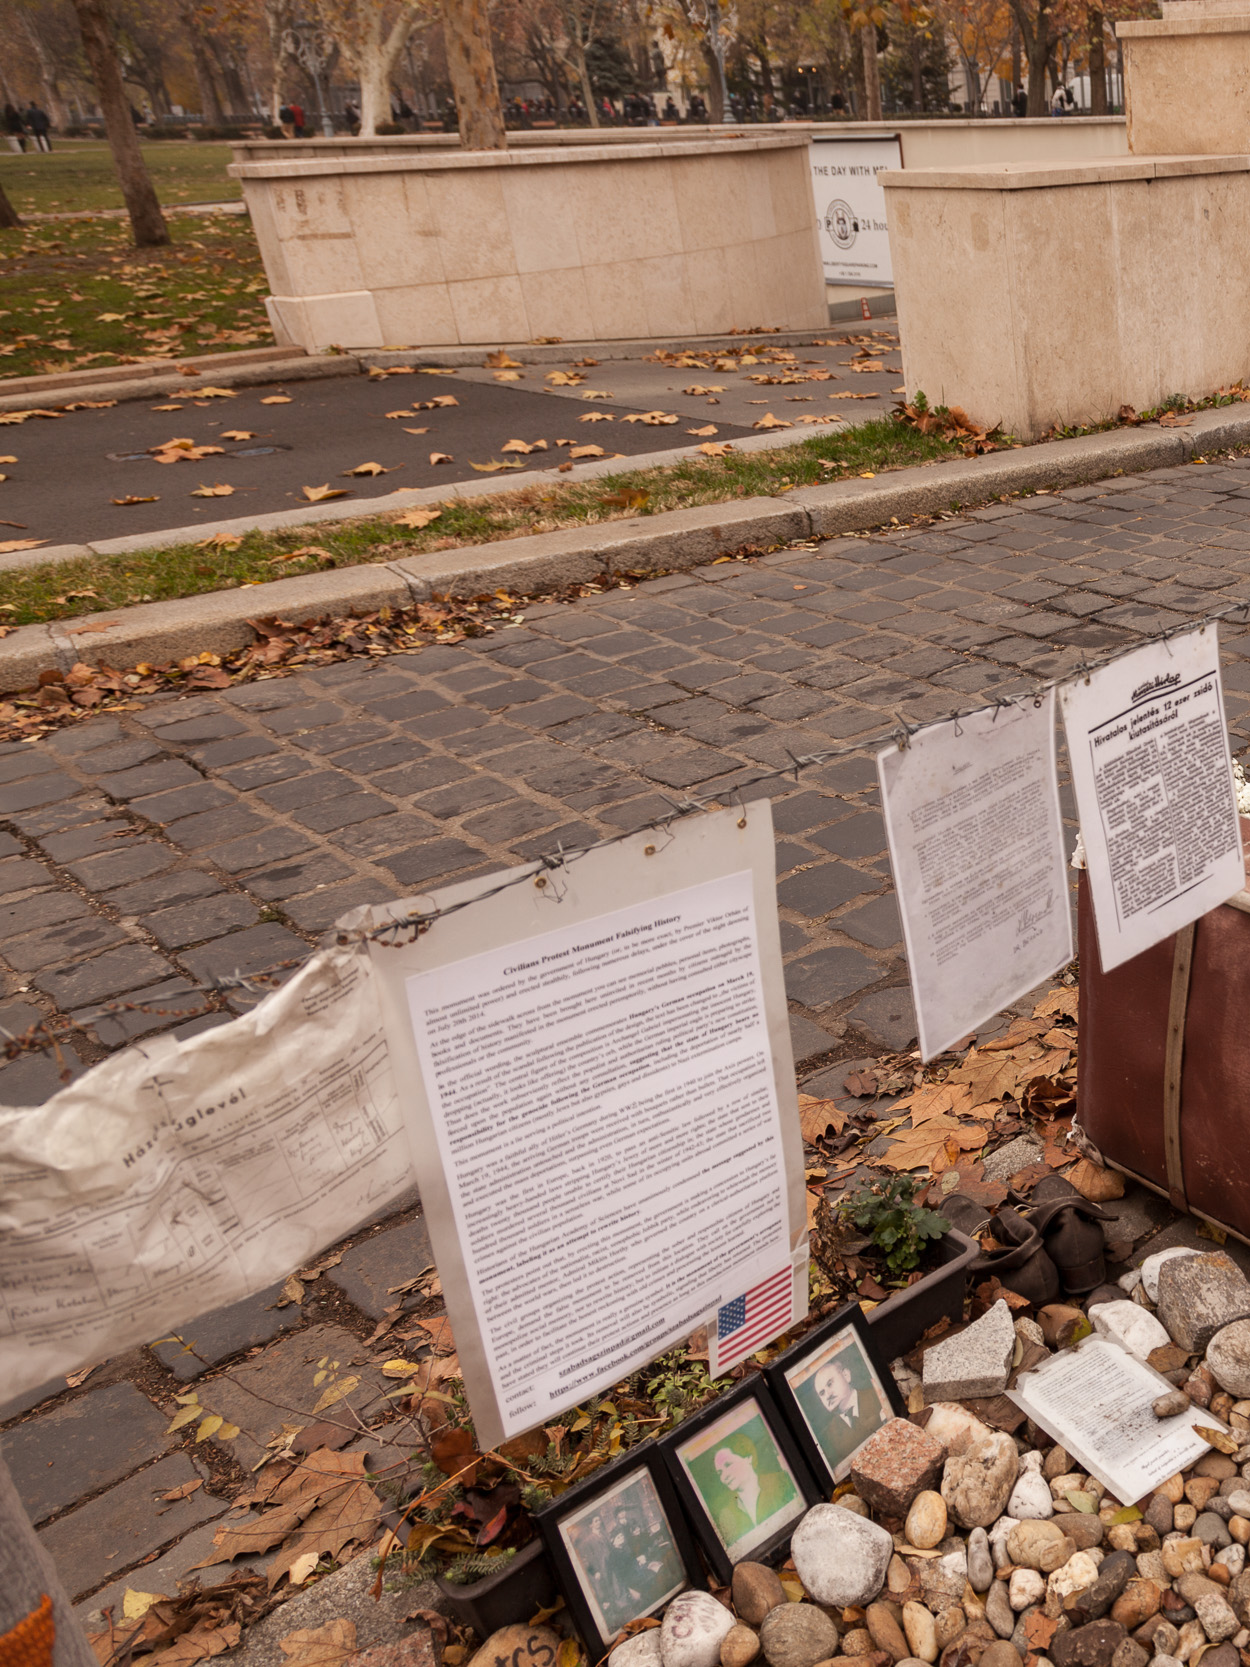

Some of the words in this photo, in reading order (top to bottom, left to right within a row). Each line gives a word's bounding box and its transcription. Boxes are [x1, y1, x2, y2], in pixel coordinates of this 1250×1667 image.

[813, 166, 828, 176] THE
[831, 166, 846, 176] DAY
[849, 166, 870, 176] WITH
[861, 219, 871, 230] 24
[1093, 724, 1128, 748] Hivatalos
[1130, 707, 1160, 729] jelentés
[1163, 700, 1172, 711] 12
[1174, 694, 1190, 707] ezer
[1193, 681, 1213, 698] zsidó
[503, 959, 540, 975] Civilians
[541, 948, 570, 963] Protest
[571, 934, 614, 953] Monument
[615, 924, 653, 939] Falsifying
[654, 915, 681, 927] History
[504, 1384, 534, 1403] contact:
[508, 1400, 536, 1418] follow:
